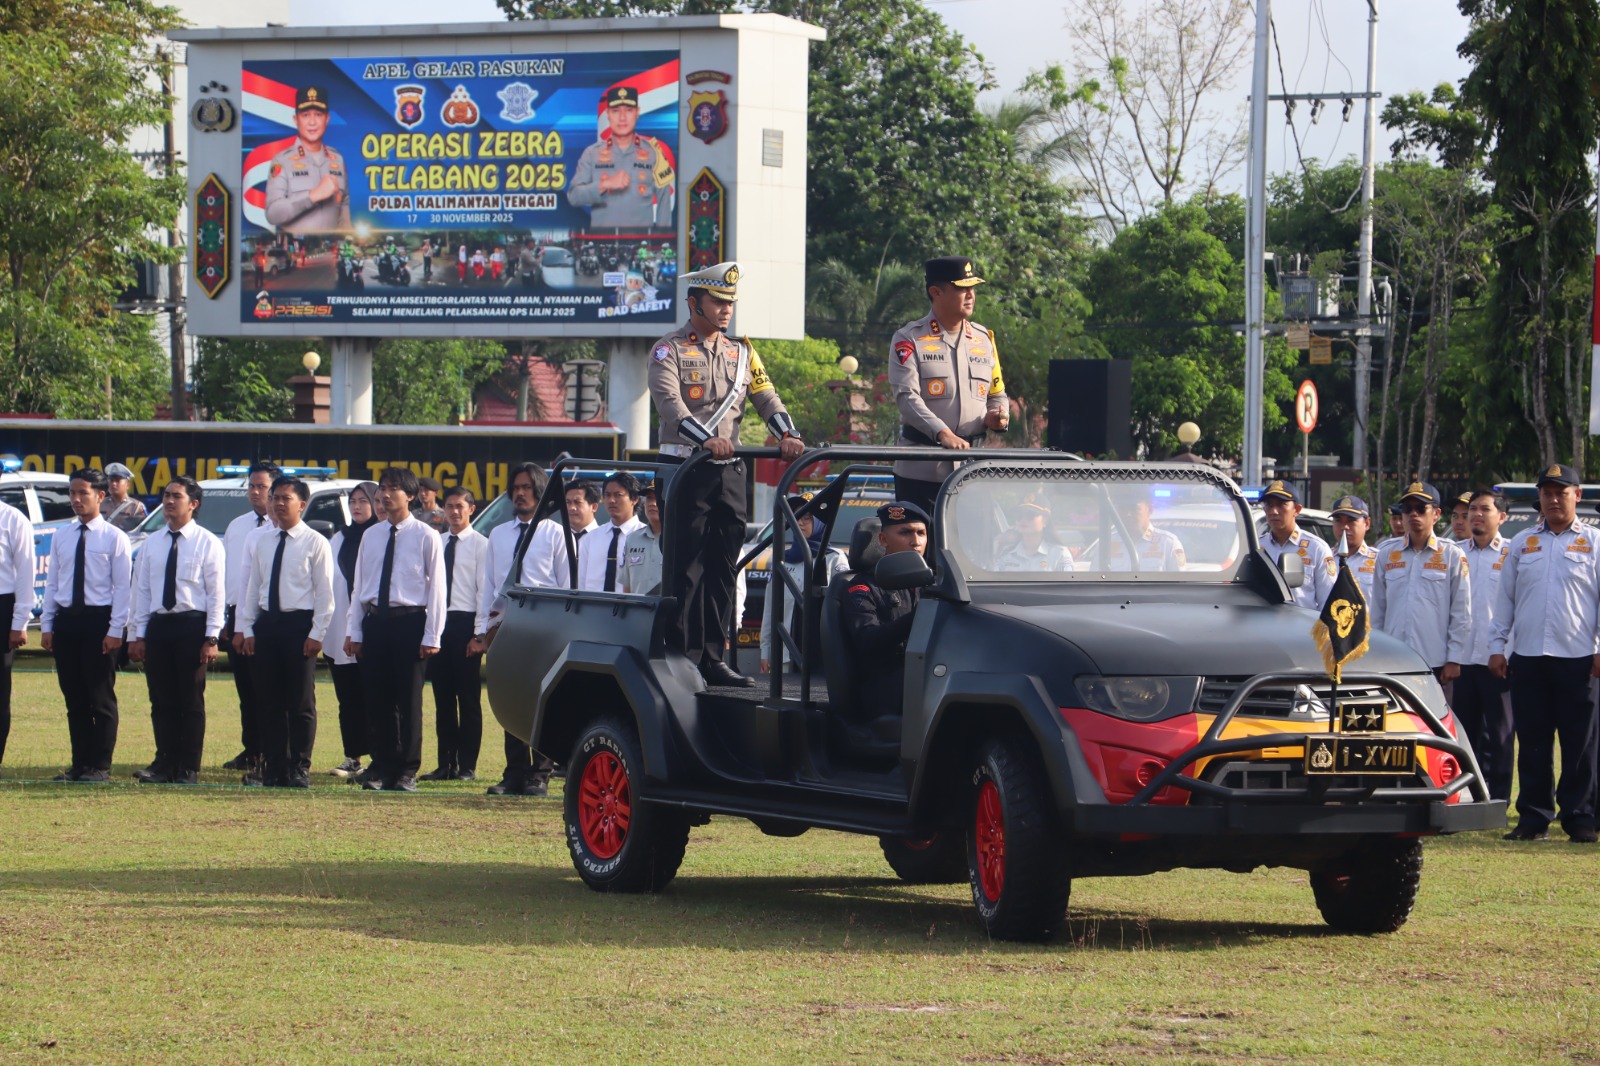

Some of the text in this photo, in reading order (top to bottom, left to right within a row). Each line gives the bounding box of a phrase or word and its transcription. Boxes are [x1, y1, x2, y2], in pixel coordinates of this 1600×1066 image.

[363, 59, 564, 79] APEL GELAR PASUKAN
[361, 130, 563, 159] OPERASI ZEBRA
[365, 163, 565, 191] TELABANG 2025
[369, 193, 556, 211] POLDA KALIMANTAN TENGAH
[407, 213, 513, 223] 17 30 NOVEMBER 2025
[326, 296, 602, 305] TERWUJUDNYA KAMSELTIBCARLANTAS YANG AMAN, NYAMAN DAN
[630, 299, 672, 315] SAFETY
[274, 305, 333, 315] PRESISI
[352, 308, 576, 316] SELAMAT MENJELANG PELAKSANAAN OPS LILIN 2025
[922, 353, 945, 361] IWAN
[583, 738, 595, 753] GT
[583, 855, 621, 873] SAVERO
